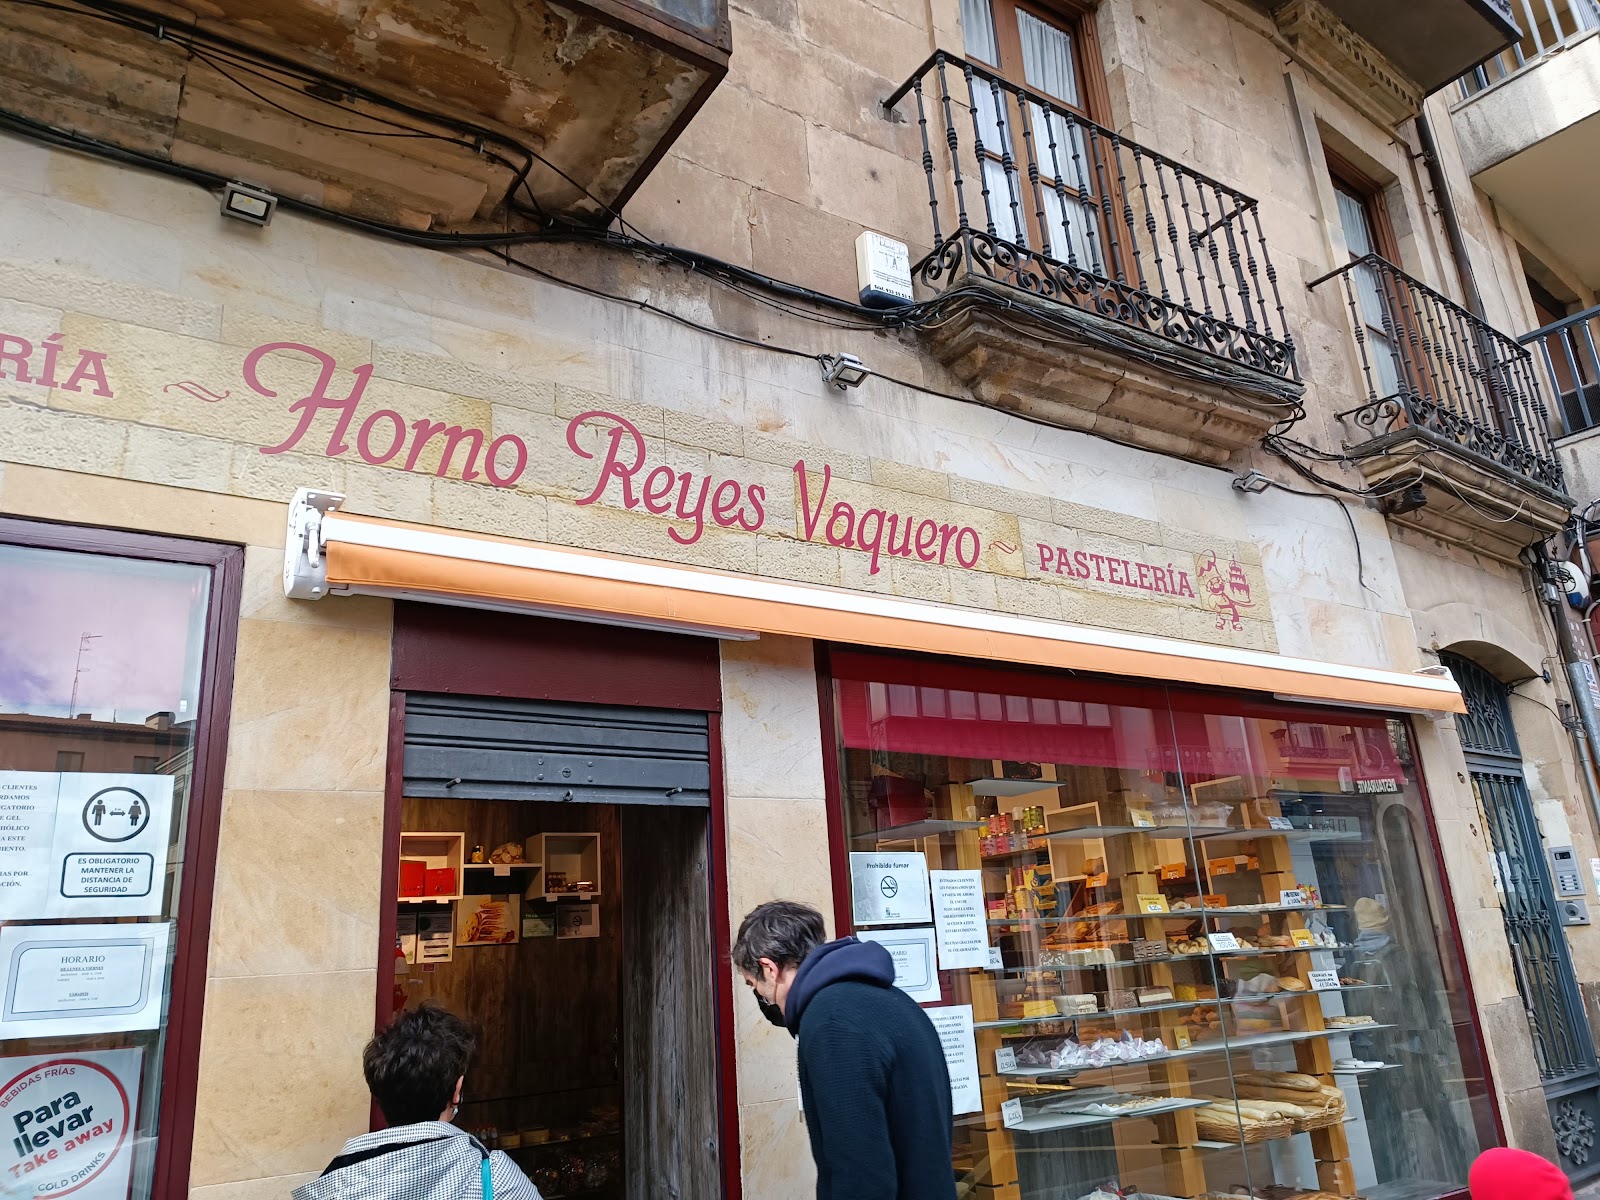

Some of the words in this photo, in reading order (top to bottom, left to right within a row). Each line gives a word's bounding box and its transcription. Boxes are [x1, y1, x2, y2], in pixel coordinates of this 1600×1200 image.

[0, 333, 114, 398] RÍA
[242, 341, 528, 487] Horno
[566, 410, 766, 545] Reyes
[792, 459, 981, 575] Vaquero
[1036, 542, 1196, 598] PASTELERÍA
[61, 955, 106, 964] HORARIO
[0, 1074, 42, 1108] BEBIDAS
[44, 1066, 76, 1079] FRÍAS
[12, 1091, 81, 1134] Para
[8, 1148, 58, 1178] Take
[64, 1118, 113, 1151] away
[12, 1105, 94, 1158] llevar
[38, 1179, 69, 1192] COLD
[70, 1151, 106, 1183] DRINKS
